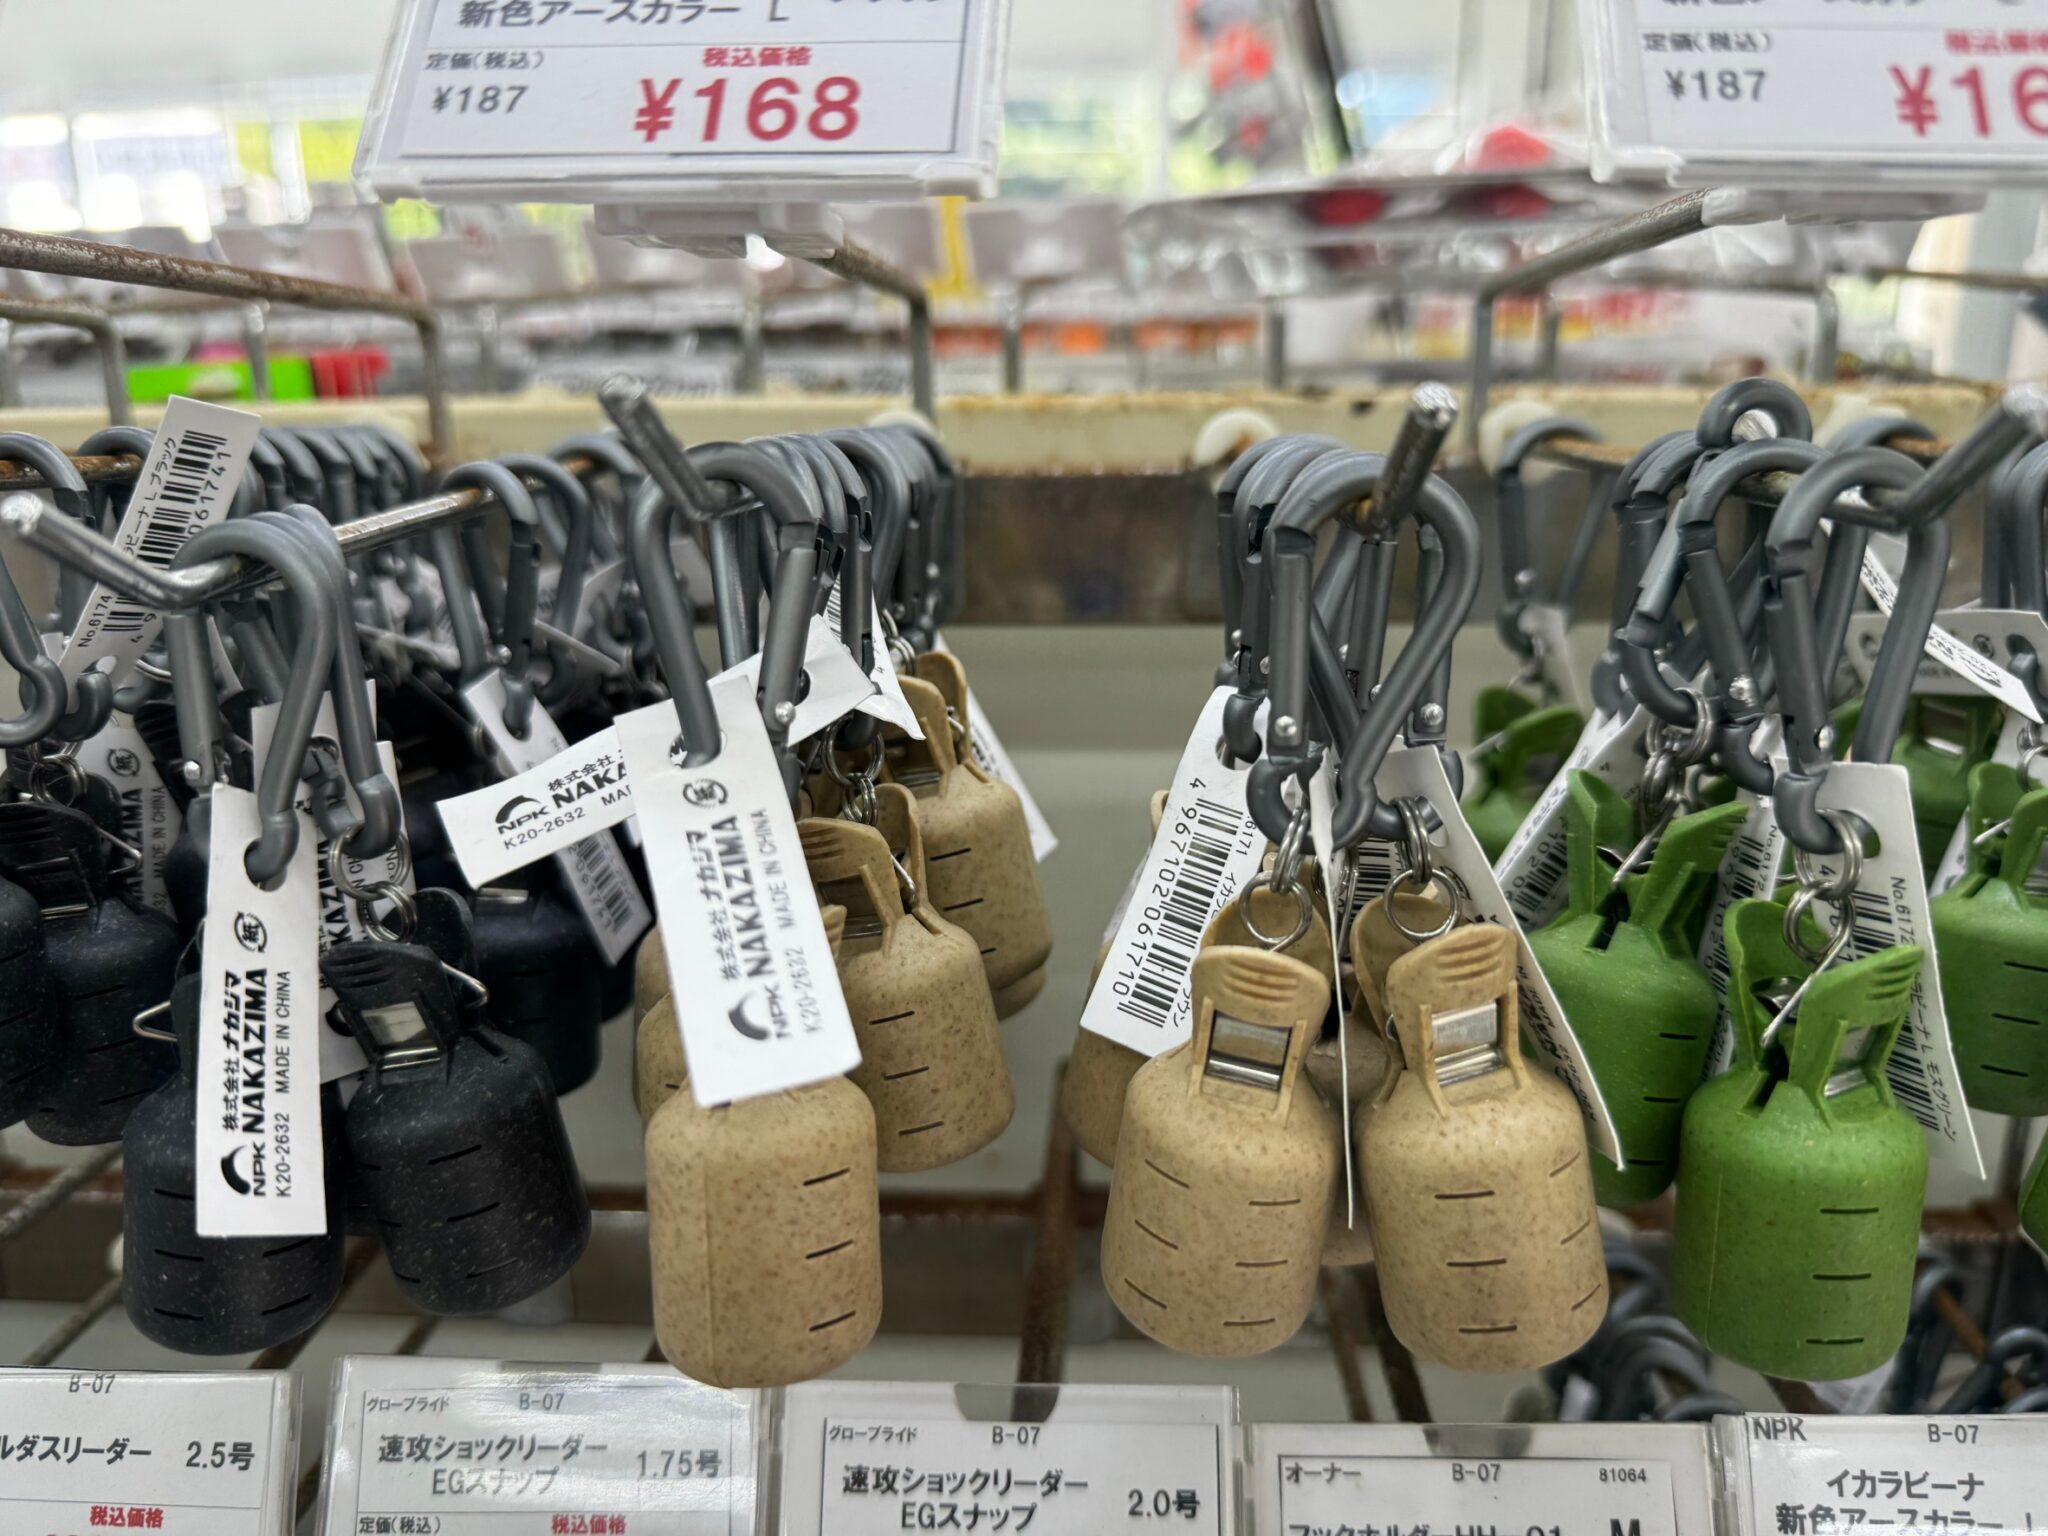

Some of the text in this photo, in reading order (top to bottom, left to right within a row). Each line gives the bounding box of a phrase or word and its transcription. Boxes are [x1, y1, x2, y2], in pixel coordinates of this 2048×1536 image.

[425, 51, 544, 70] 定価(税込)
[702, 46, 812, 68] 税込価格
[432, 85, 529, 114] ¥187
[1665, 70, 1768, 101] ¥187
[634, 76, 862, 143] ¥168
[150, 437, 177, 487] ブラック
[548, 755, 615, 792] 株式会社
[497, 806, 550, 834] NPK
[504, 807, 586, 850] K20-2632
[751, 807, 778, 856] CHINA
[711, 815, 776, 978] NAKAZIMA
[769, 880, 796, 931] MADE
[223, 970, 241, 1130] 株式会社 ナカジマ
[242, 968, 267, 1134] NAKAZIMA
[275, 970, 291, 1198] K20-2632 MADE IN CHINA
[253, 1142, 266, 1197] NPK
[69, 1374, 116, 1394] B-07
[519, 1393, 565, 1411] B-07
[992, 1426, 1041, 1446] B-07
[1753, 1417, 1978, 1444] NPK B-07
[186, 1441, 255, 1471] 2.5号
[378, 1434, 722, 1479] 速攻ショックリーダー 1.75号
[432, 1465, 559, 1495] EGスナップ
[1285, 1463, 1646, 1483] オーナー B-07 81064
[1826, 1469, 1984, 1501] イカラビーナ
[842, 1464, 1200, 1518] 速攻ショックリーダー 2.0号
[90, 1505, 164, 1529] 税込価格
[359, 1514, 626, 1535] 定価(税込) 税込価格
[901, 1502, 1037, 1531] EGスナップ
